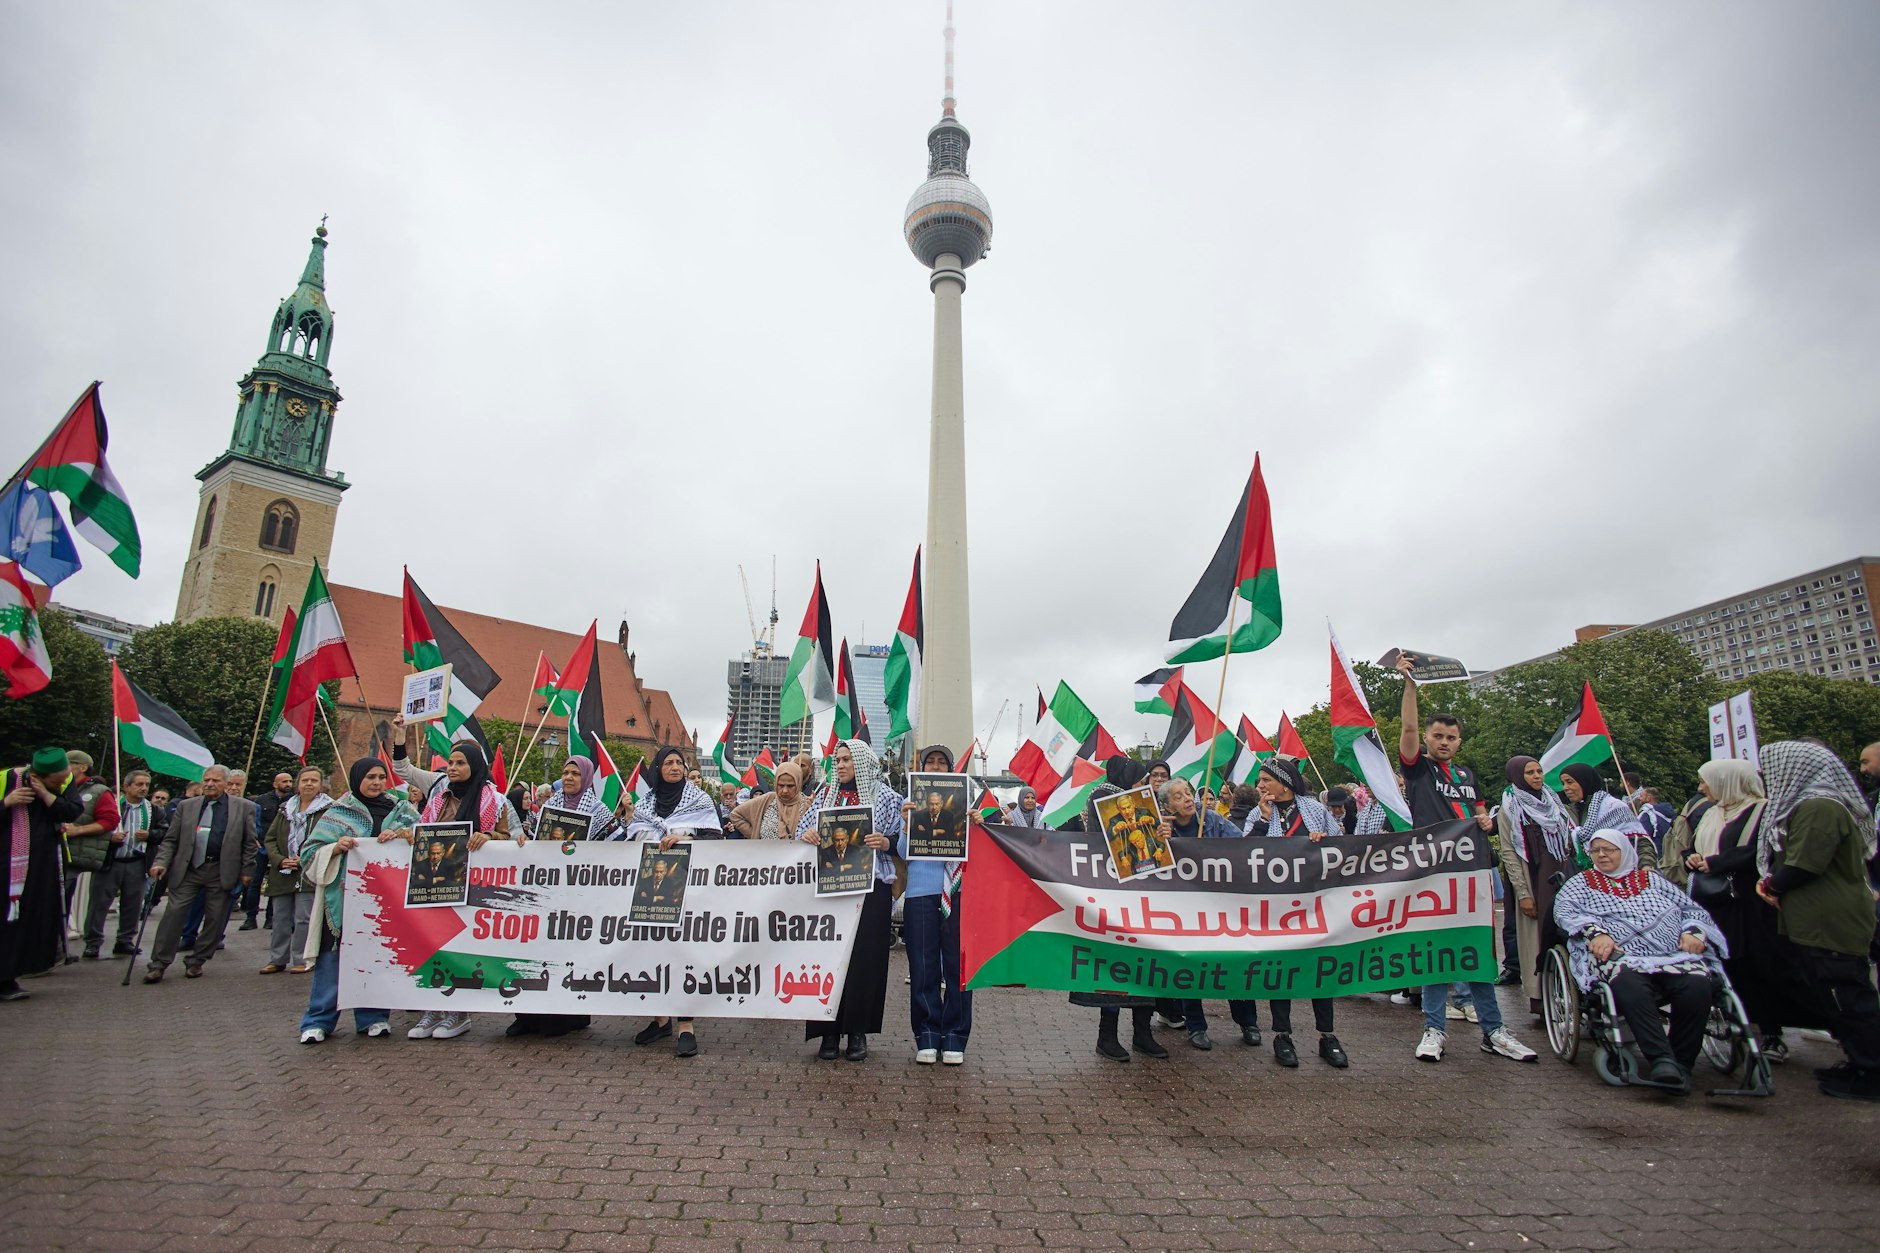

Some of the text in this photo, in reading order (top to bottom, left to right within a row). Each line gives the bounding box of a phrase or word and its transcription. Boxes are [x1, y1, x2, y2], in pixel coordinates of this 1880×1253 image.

[870, 644, 890, 654] park
[470, 866, 517, 888] oppt
[522, 865, 559, 886] den
[566, 864, 637, 886] Völker
[714, 862, 816, 886] Gazastreif
[1247, 847, 1306, 884] for
[1320, 833, 1475, 881] Palestine
[472, 909, 540, 943] Stop
[547, 910, 593, 941] the
[733, 911, 760, 942] in
[768, 910, 842, 942] Gaza.
[1075, 876, 1476, 943] الحرية لفلسطين
[430, 961, 835, 1006] وقفوا الإبادة الجماعية في غزة
[1070, 940, 1479, 991] Freiheit für Palästina
